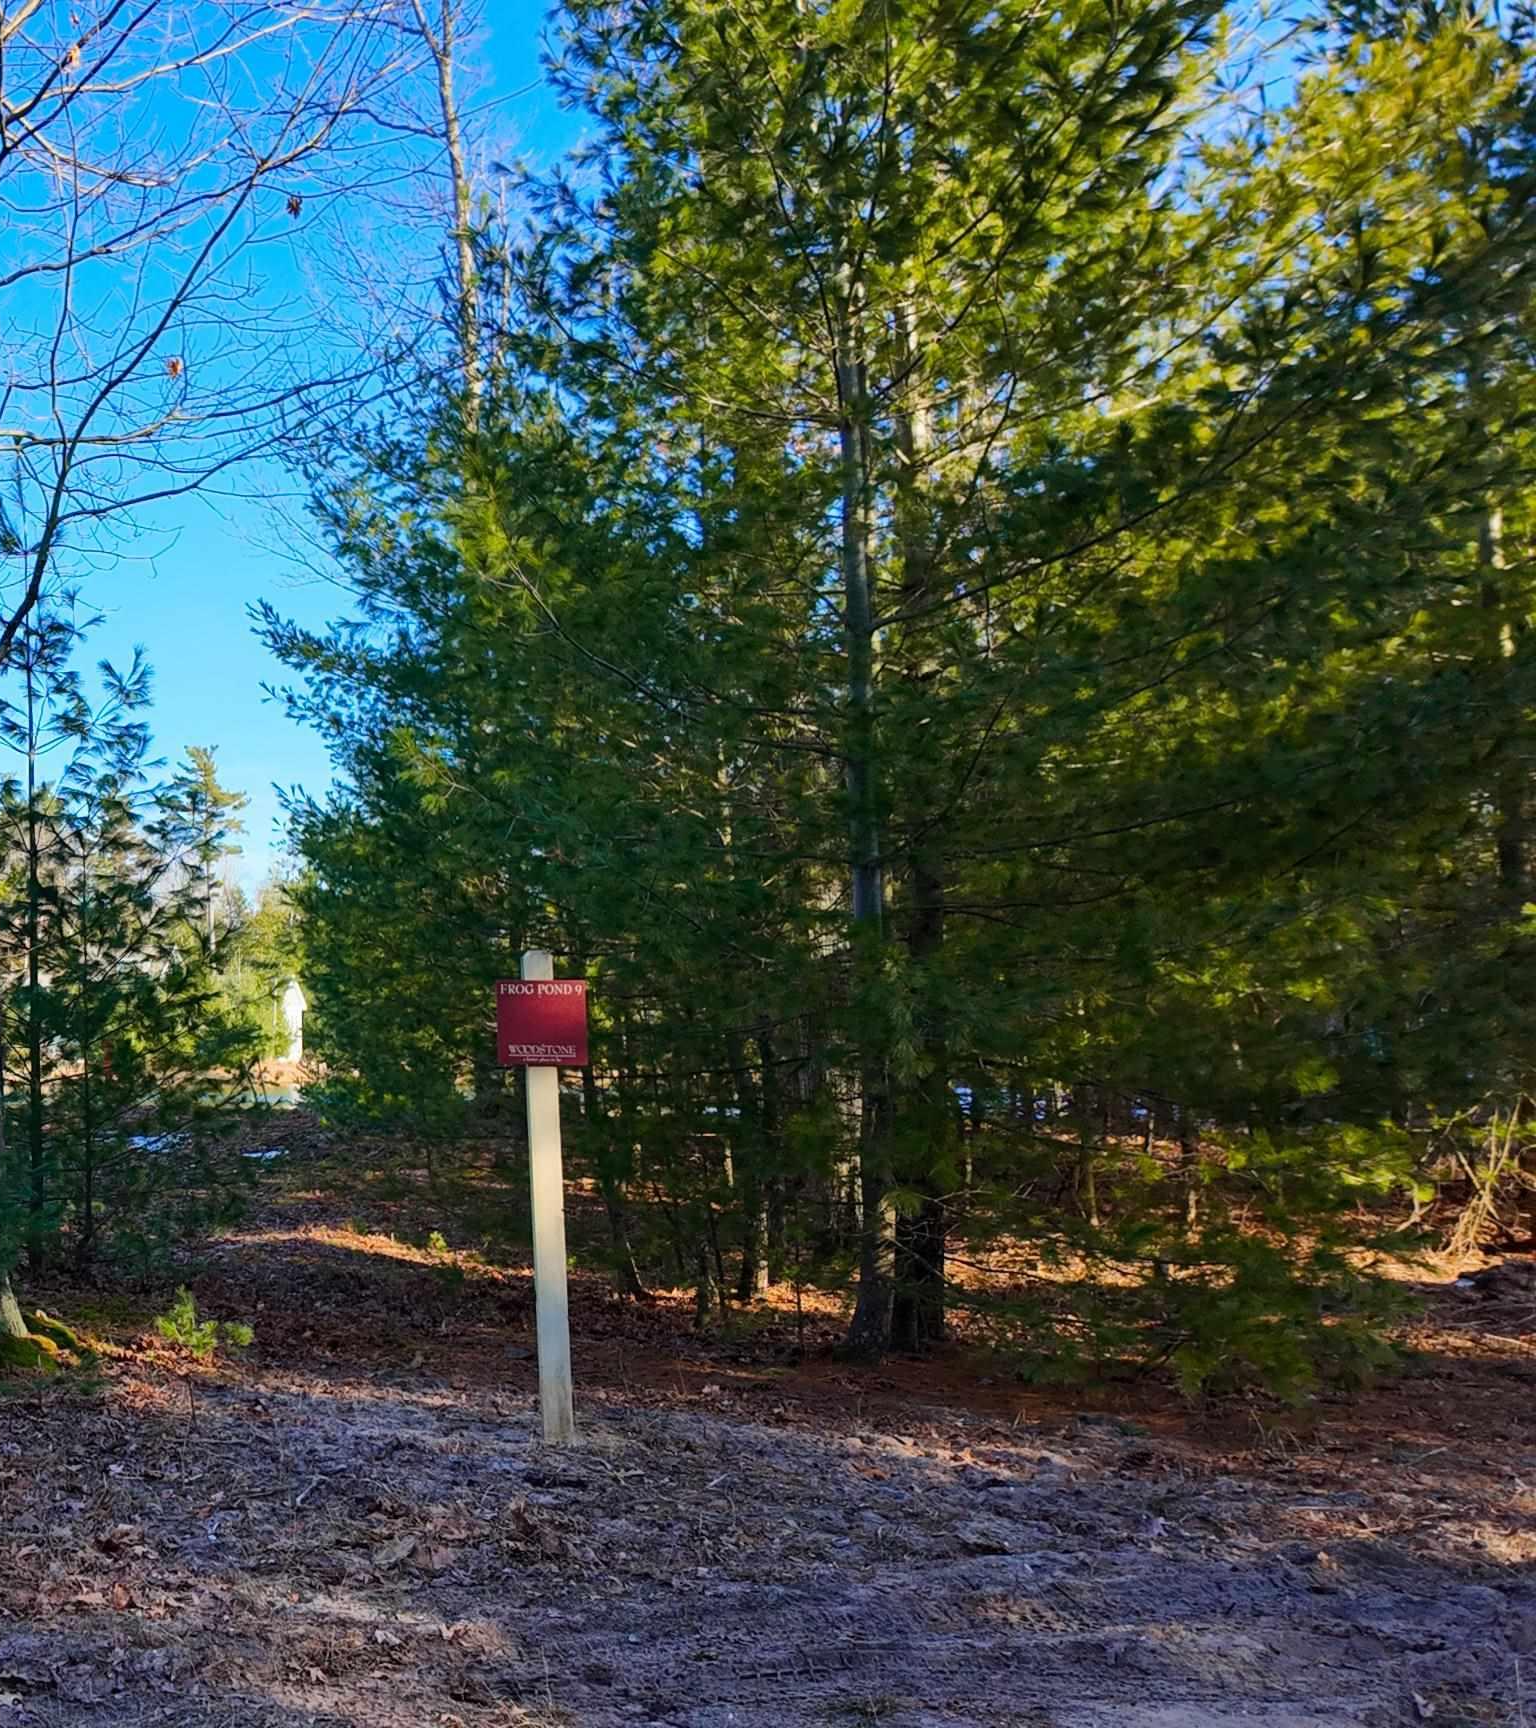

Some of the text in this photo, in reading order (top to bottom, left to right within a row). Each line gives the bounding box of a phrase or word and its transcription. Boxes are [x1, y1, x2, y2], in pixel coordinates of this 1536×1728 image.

[500, 983, 582, 995] FROG POND 9
[508, 1044, 576, 1055] WOODSTONE
